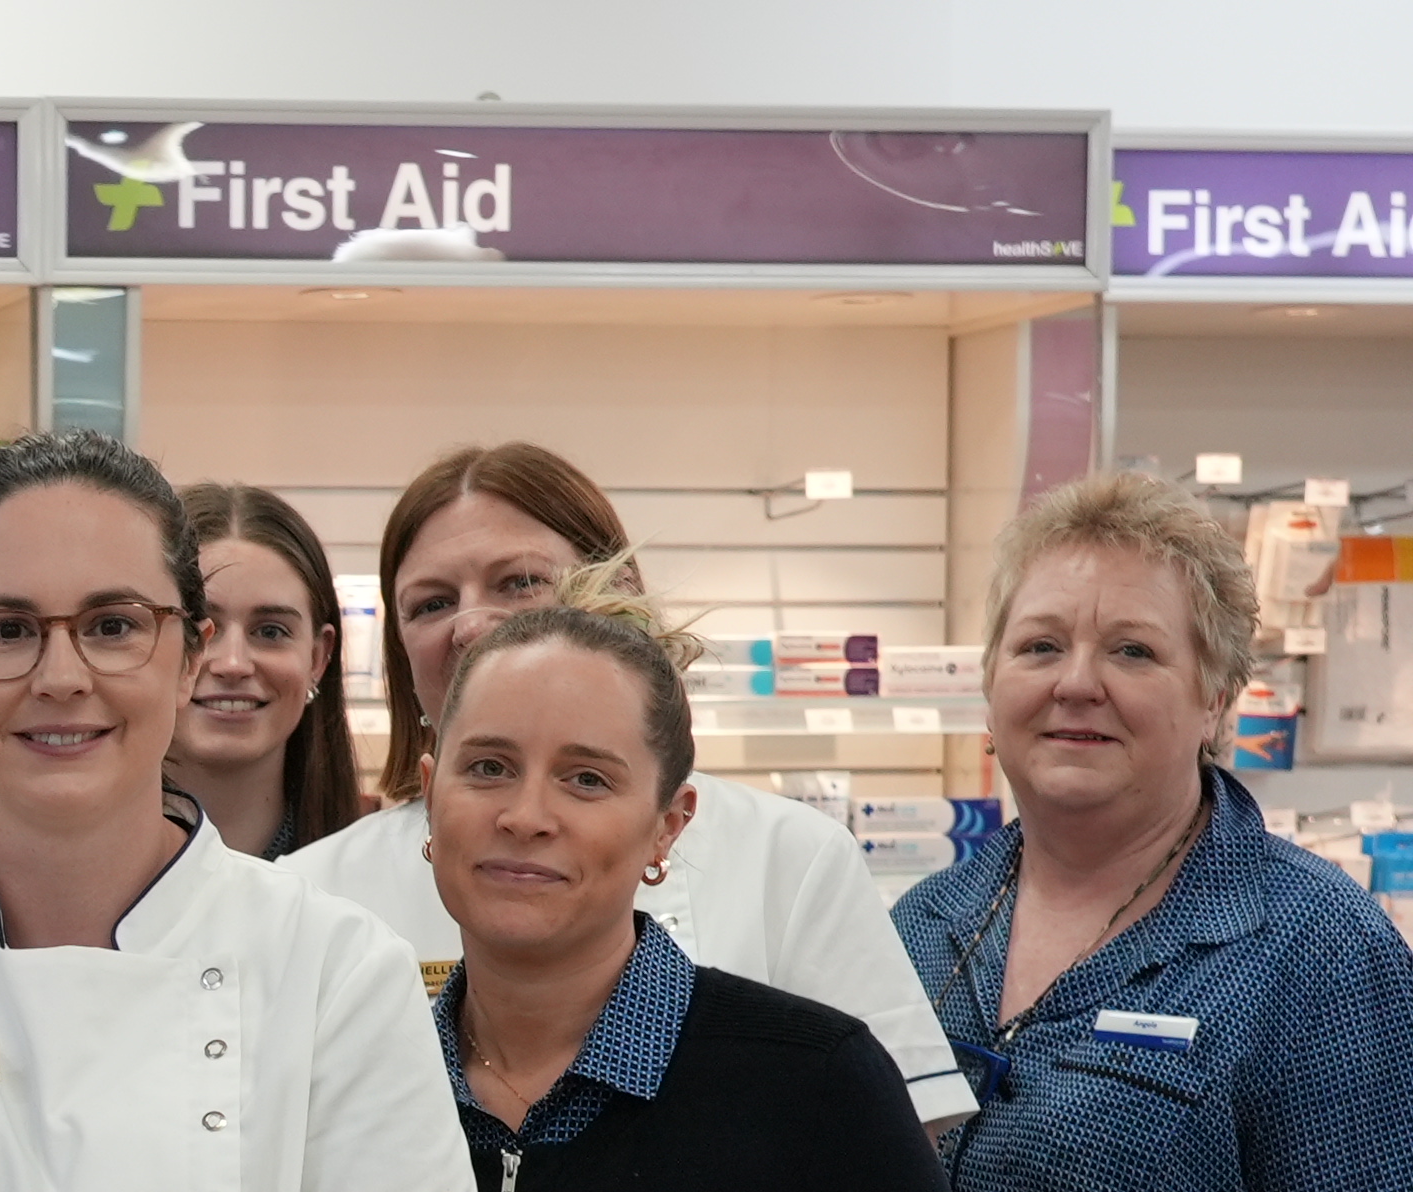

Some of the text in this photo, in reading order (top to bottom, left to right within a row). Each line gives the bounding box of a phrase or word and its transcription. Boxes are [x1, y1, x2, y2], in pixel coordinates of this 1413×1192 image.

[177, 159, 511, 233] First Aid
[1147, 189, 1413, 258] First Ai
